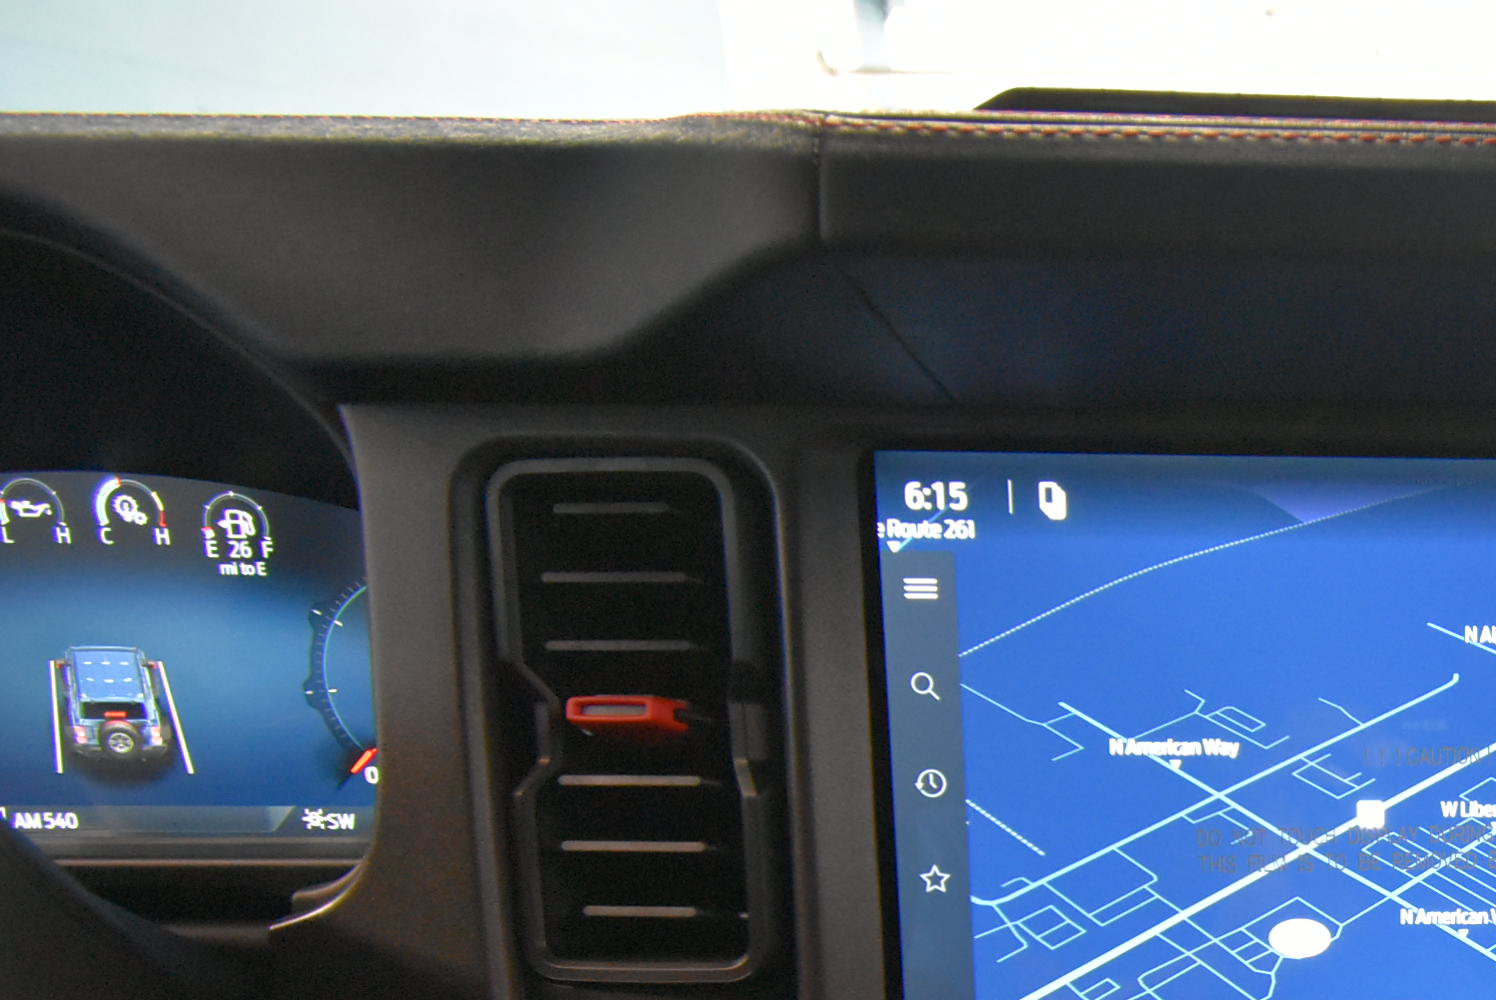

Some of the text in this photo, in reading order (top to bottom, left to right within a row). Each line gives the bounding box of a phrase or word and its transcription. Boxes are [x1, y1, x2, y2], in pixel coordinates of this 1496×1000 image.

[904, 481, 969, 512] 6:15
[886, 518, 943, 540] Route
[943, 518, 977, 540] 261
[227, 540, 253, 559] 26
[218, 561, 238, 576] mi
[239, 560, 256, 576] to
[1464, 626, 1478, 643] N
[1109, 738, 1240, 759] N American Way
[1440, 801, 1459, 817] W
[13, 812, 42, 830] AM
[42, 812, 80, 830] 540
[327, 813, 356, 830] SW
[1400, 908, 1414, 925] N
[1414, 908, 1489, 926] American
